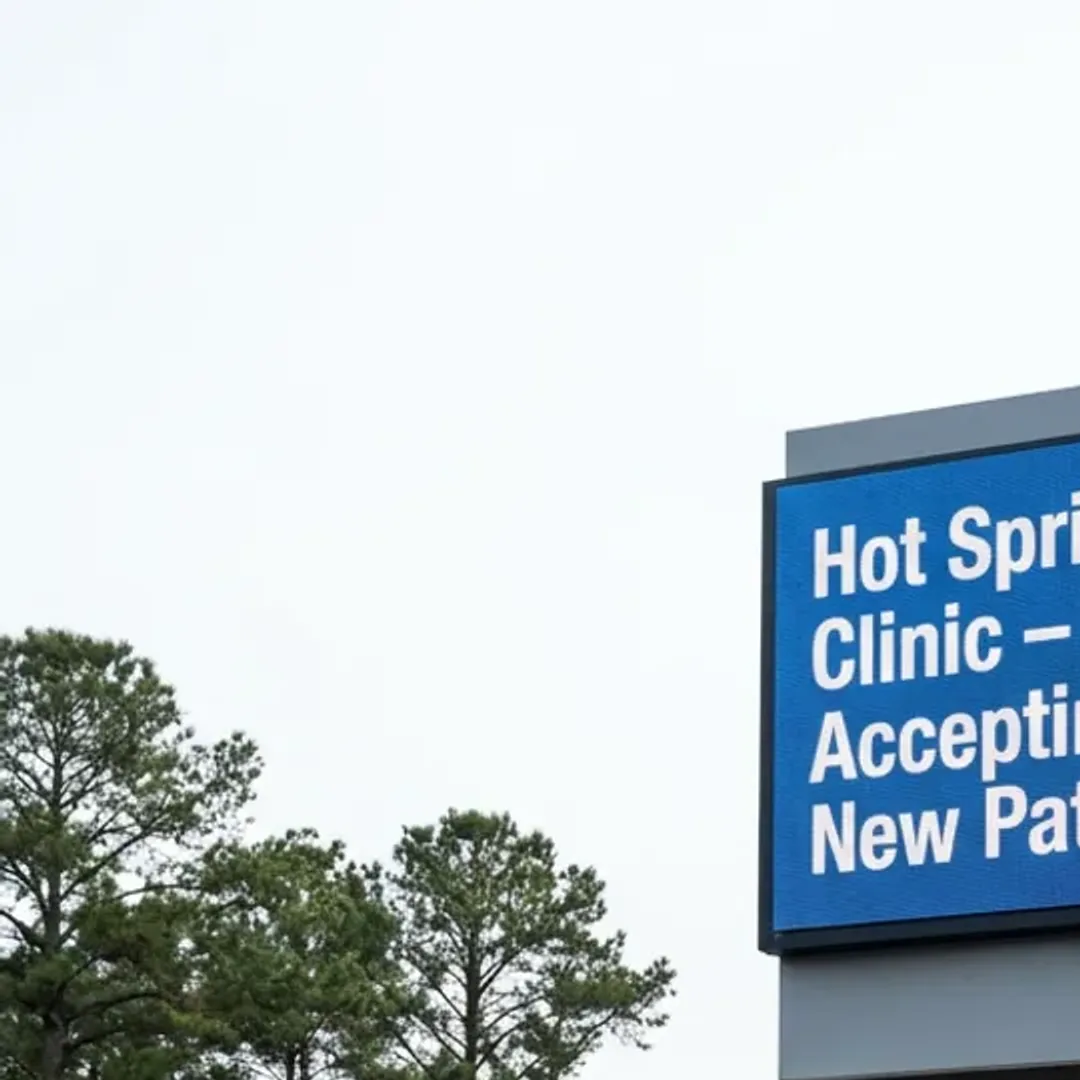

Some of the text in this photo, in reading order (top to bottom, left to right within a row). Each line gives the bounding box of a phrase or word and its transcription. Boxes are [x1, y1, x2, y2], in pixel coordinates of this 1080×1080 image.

[813, 516, 927, 599] Hot
[812, 602, 1003, 690] Clinic
[811, 800, 960, 875] New
